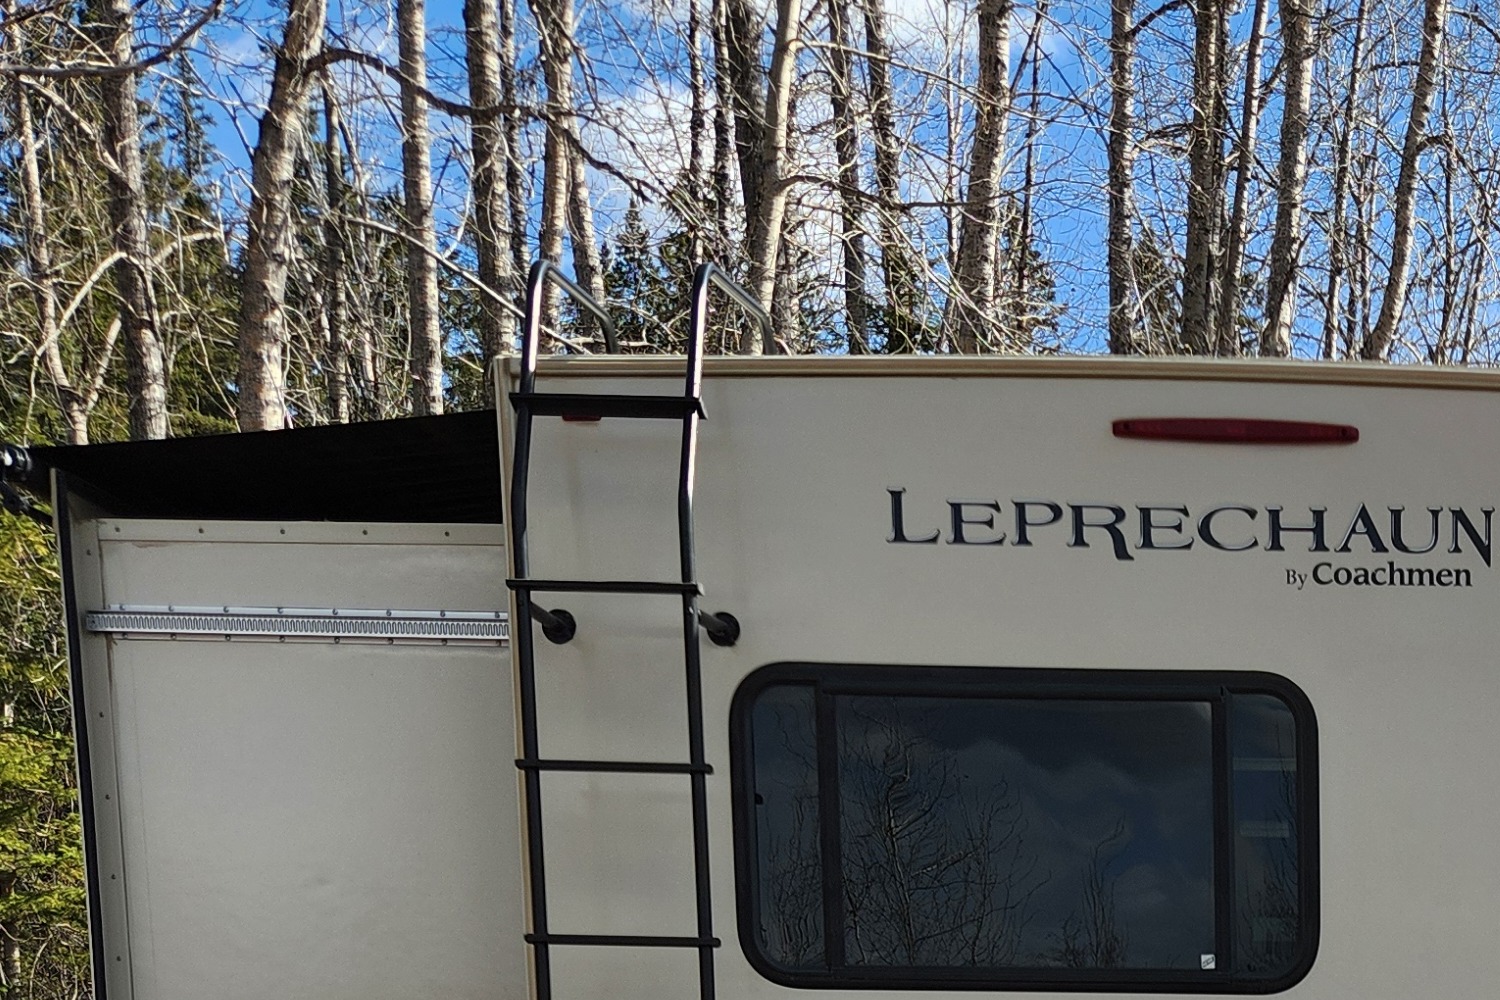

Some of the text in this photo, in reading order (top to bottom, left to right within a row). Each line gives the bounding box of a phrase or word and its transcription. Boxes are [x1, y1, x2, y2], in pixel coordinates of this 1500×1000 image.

[886, 486, 1495, 568] LEPRECHAUN
[1285, 562, 1473, 590] By Coachmen
